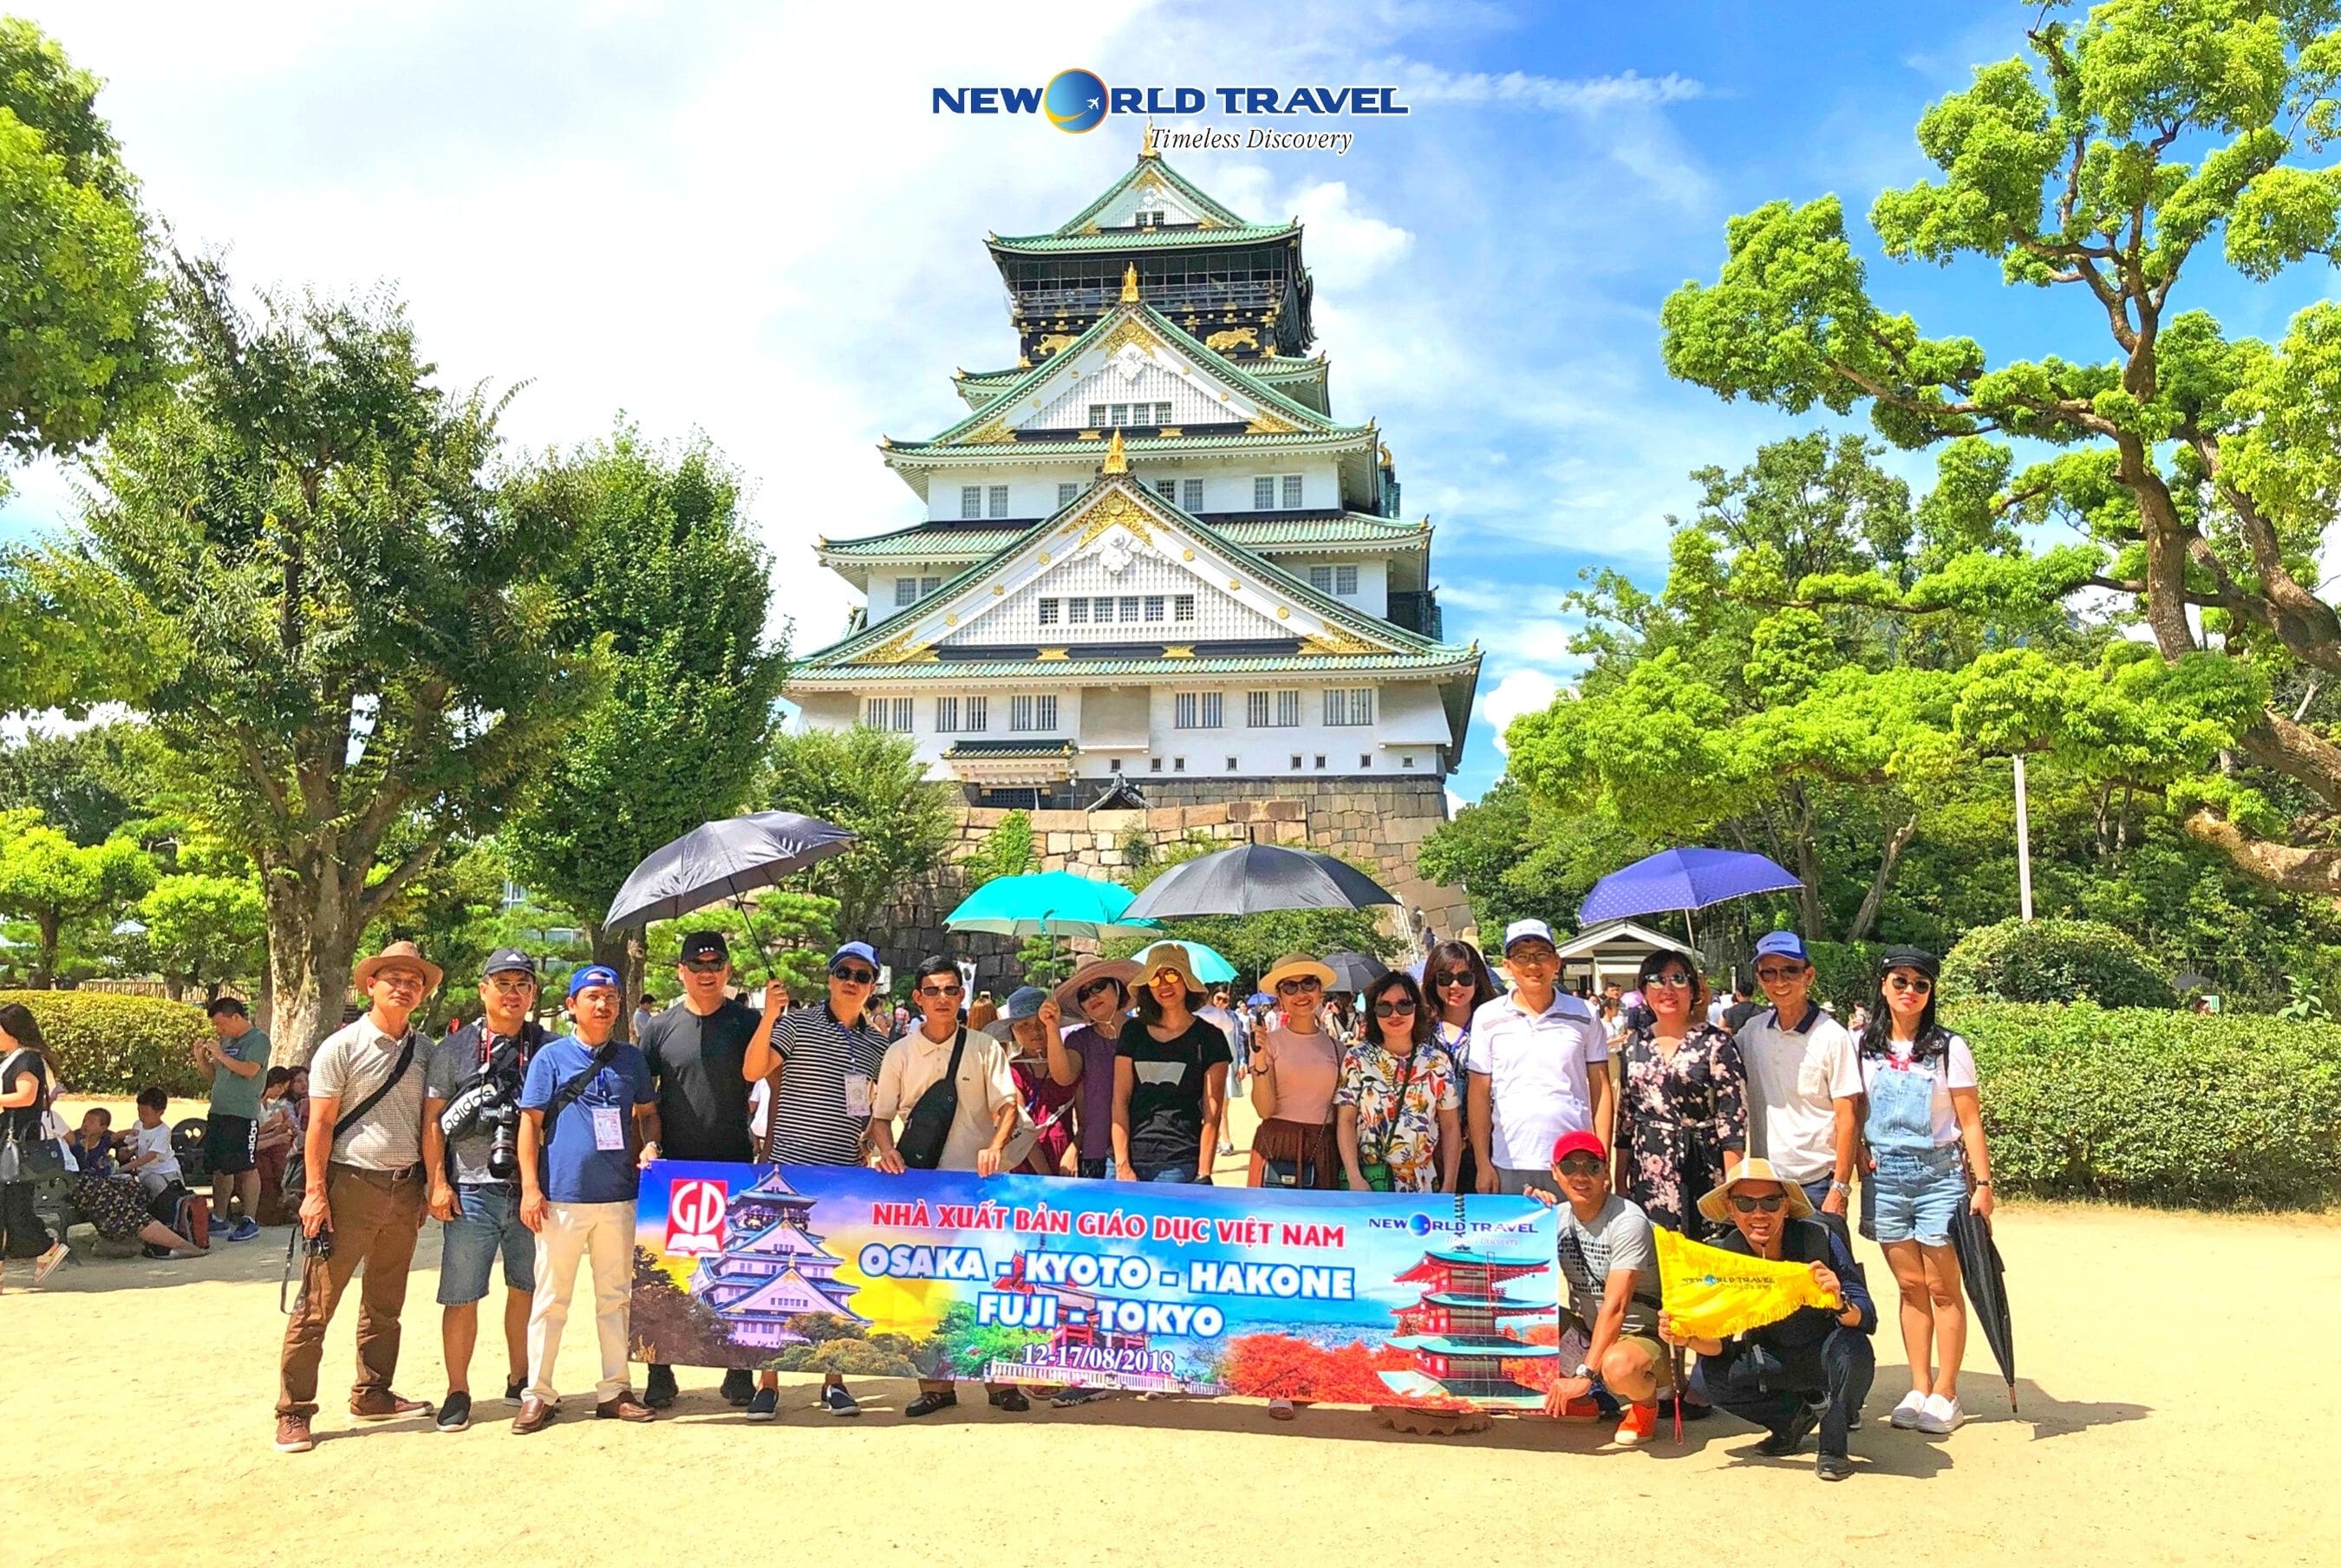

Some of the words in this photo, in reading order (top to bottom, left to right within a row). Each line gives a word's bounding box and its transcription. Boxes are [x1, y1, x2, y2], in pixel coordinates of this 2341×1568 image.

[444, 1085, 496, 1132] adidas
[672, 1180, 726, 1235] GD
[872, 1199, 929, 1227] NHÀ
[937, 1200, 1007, 1230] XUẤT
[1014, 1202, 1069, 1233] BẢN
[1078, 1211, 1144, 1238] GIÁO
[1155, 1217, 1210, 1245] DỤC
[1217, 1218, 1274, 1248] VIỆT
[1282, 1223, 1345, 1248] NAM
[1470, 1222, 1538, 1233] TRAVEL
[859, 1244, 988, 1280] OSAKA
[1025, 1251, 1151, 1289] KYOTO
[1190, 1260, 1355, 1299] HAKONE
[978, 1292, 1058, 1327] FUJI
[1095, 1298, 1225, 1337] TOKYO
[1022, 1344, 1175, 1373] 12-17/08/2018
